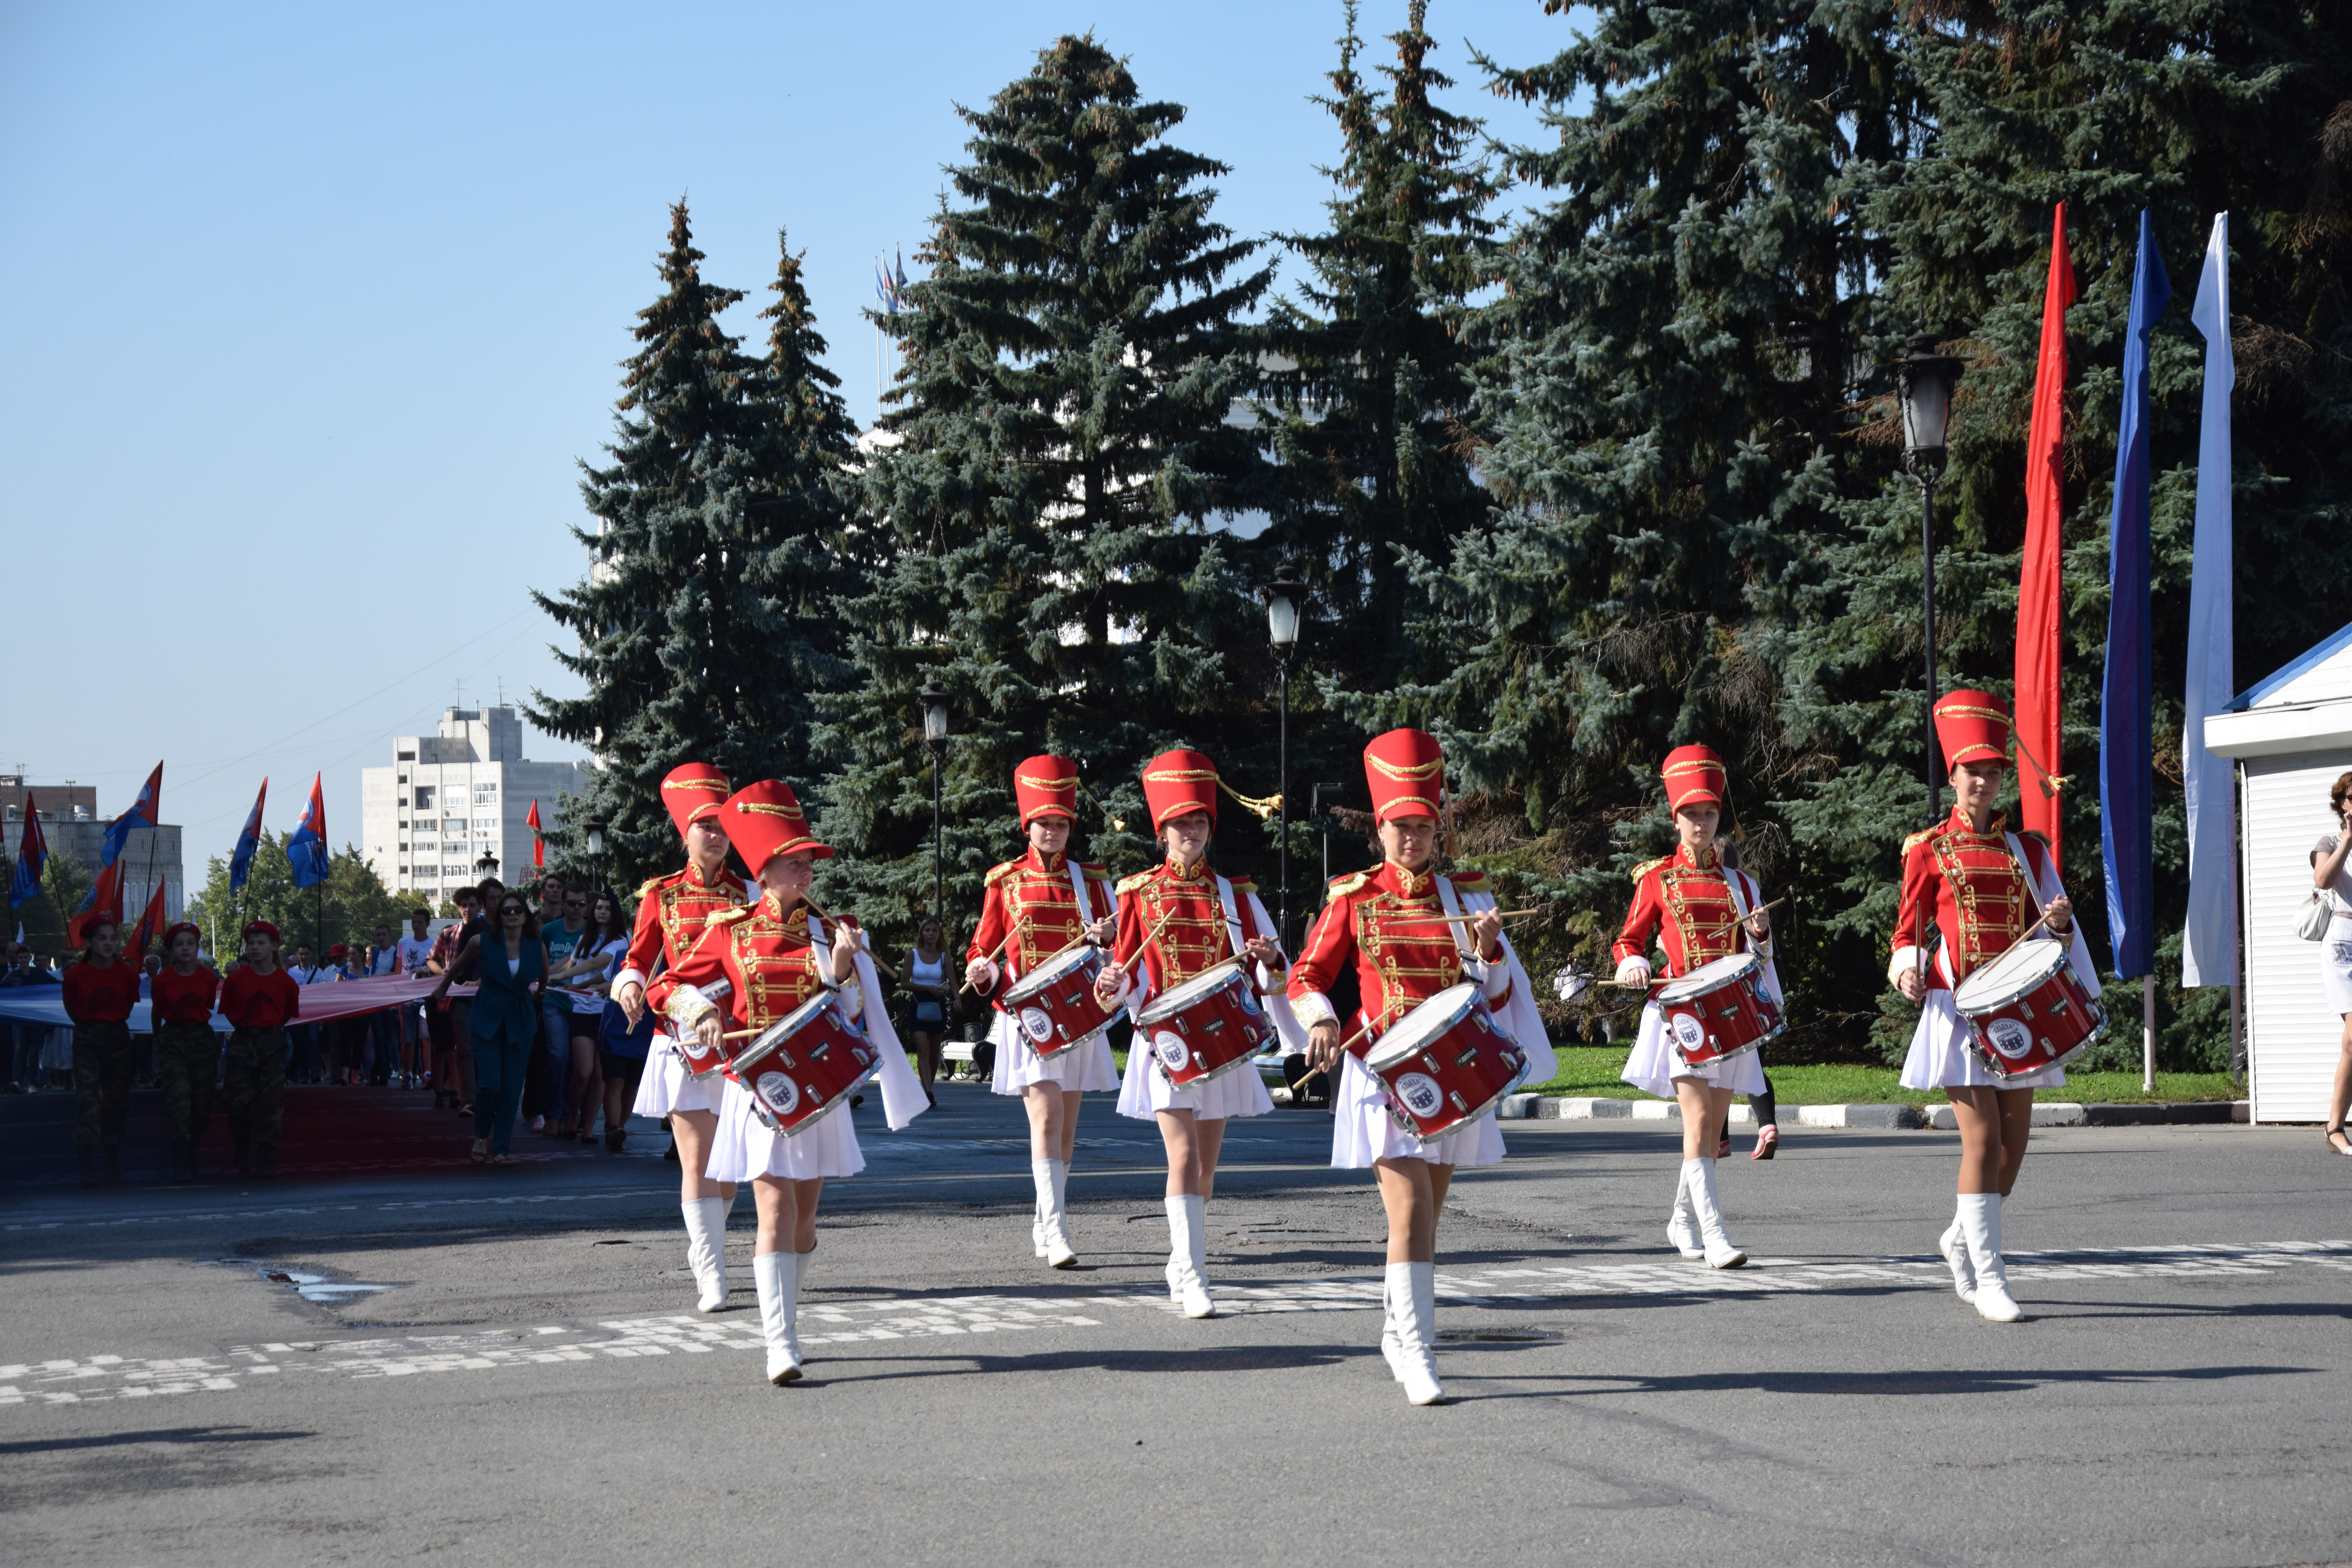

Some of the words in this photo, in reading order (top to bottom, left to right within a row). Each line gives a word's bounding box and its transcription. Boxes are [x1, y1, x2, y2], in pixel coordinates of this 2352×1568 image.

[1067, 992, 1082, 1003] OMEGA
[1721, 1005, 1739, 1016] OMEGA
[2051, 998, 2067, 1012] OMEGA
[1206, 1019, 1223, 1030] OMEGA
[1458, 1047, 1477, 1063] OMEGA
